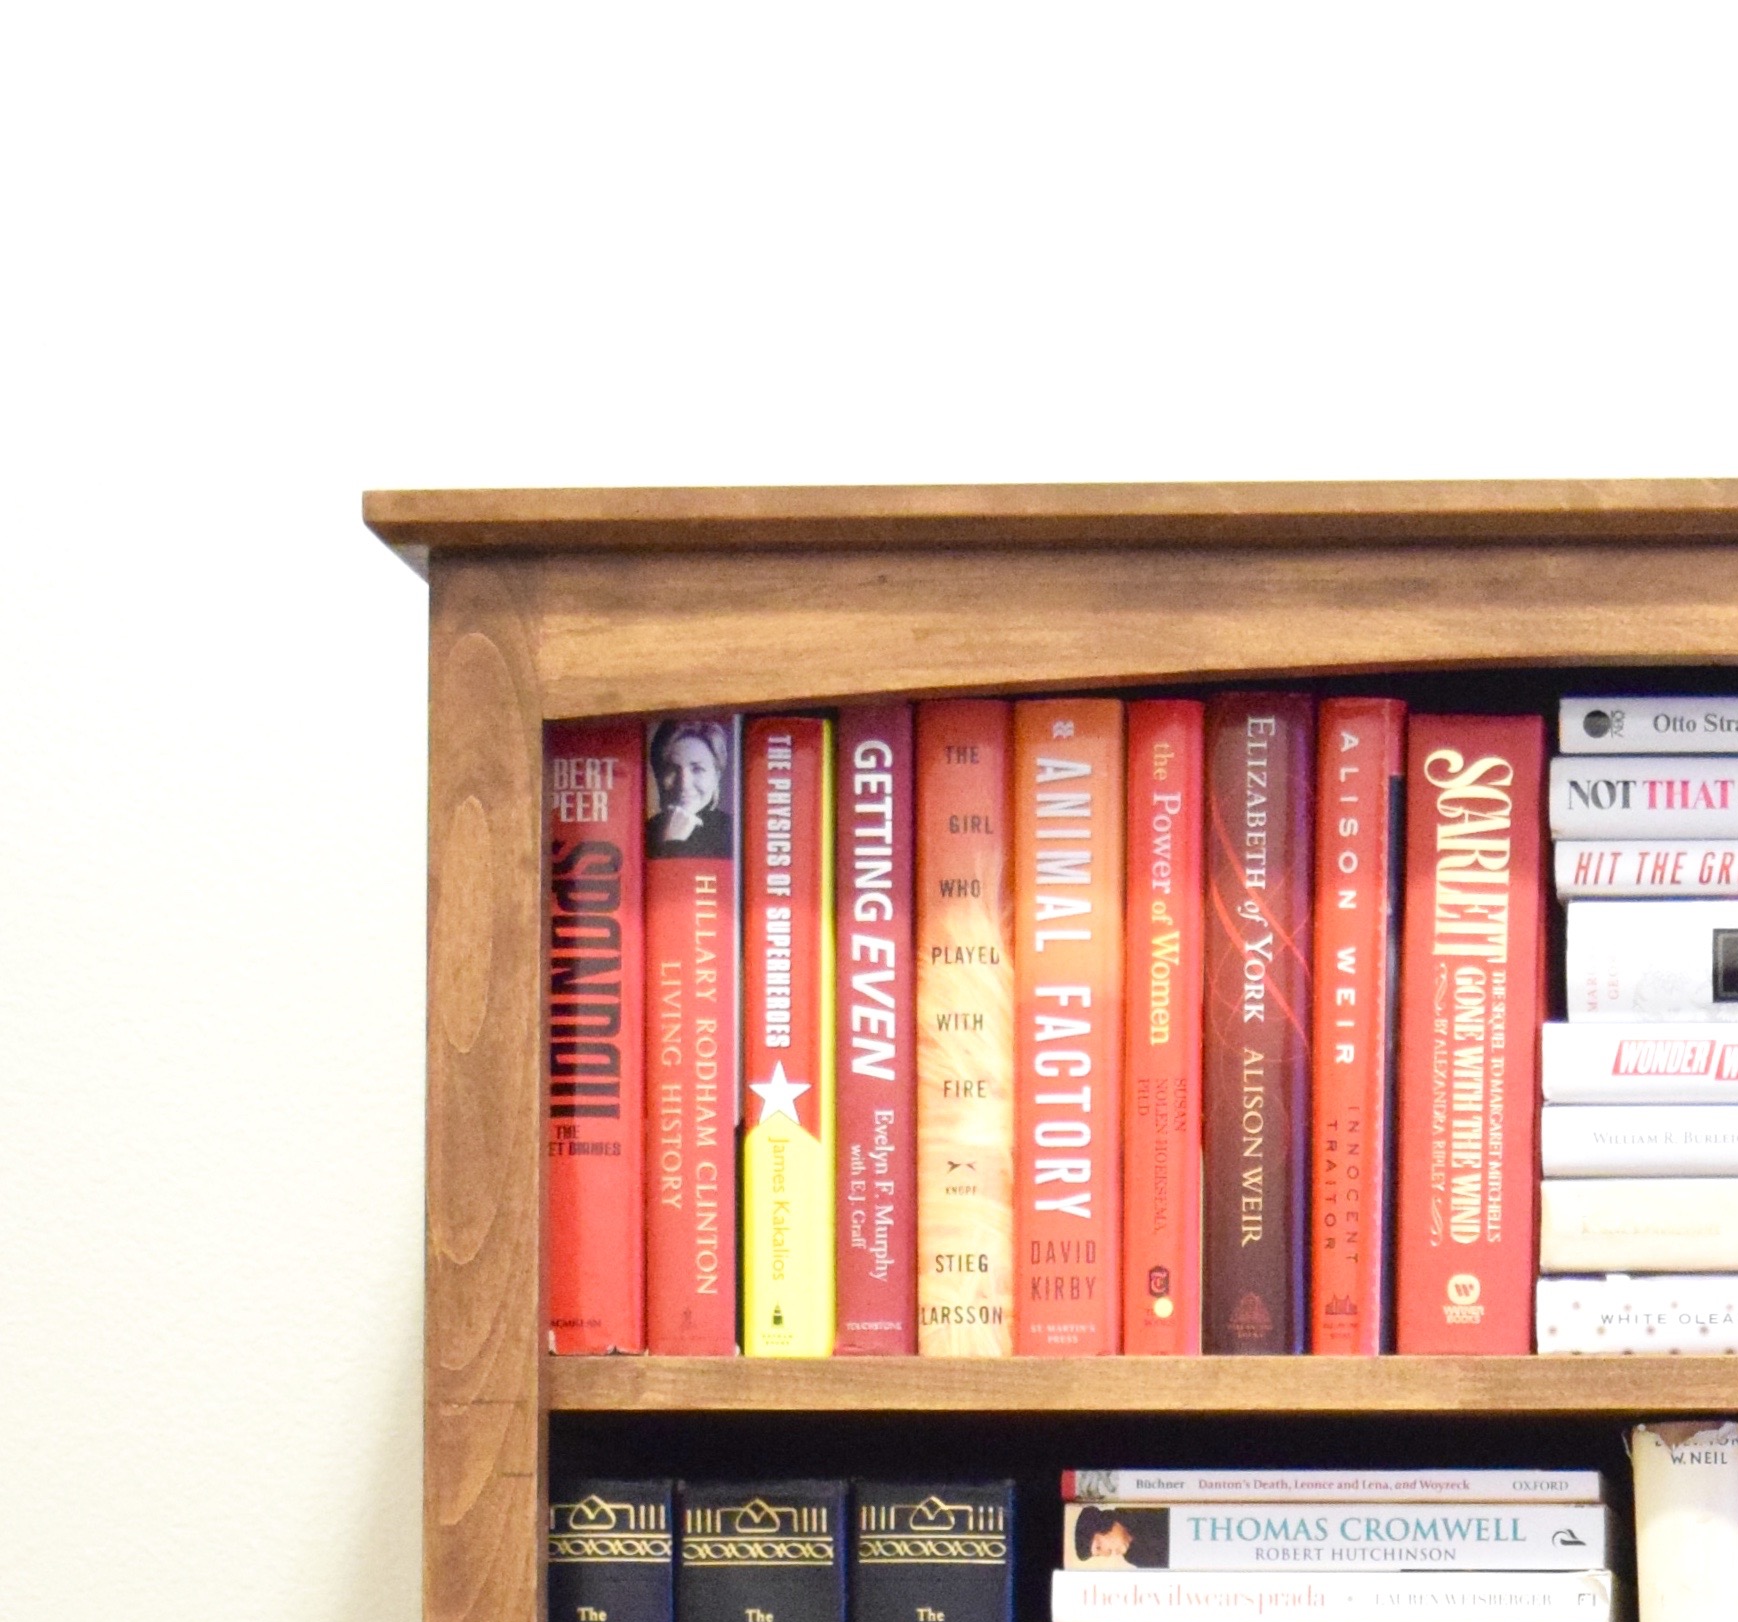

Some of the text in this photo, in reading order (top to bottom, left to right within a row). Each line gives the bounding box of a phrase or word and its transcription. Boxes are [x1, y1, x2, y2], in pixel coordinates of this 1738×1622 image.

[1653, 714, 1698, 733] Otto
[1568, 780, 1636, 810] NOT
[1643, 780, 1734, 810] THAT
[1574, 853, 1624, 887] HIT
[1635, 853, 1686, 886] THE
[764, 734, 792, 1049] THE PHYSICS OF SUPERHEROES
[850, 738, 896, 1080] GETTING EVEN
[1034, 755, 1093, 1219] ANIMAL FACTORY
[1187, 1516, 1527, 1542] THOMAS CROMWELL
[1256, 1547, 1457, 1562] ROBERT HUTCHINSON
